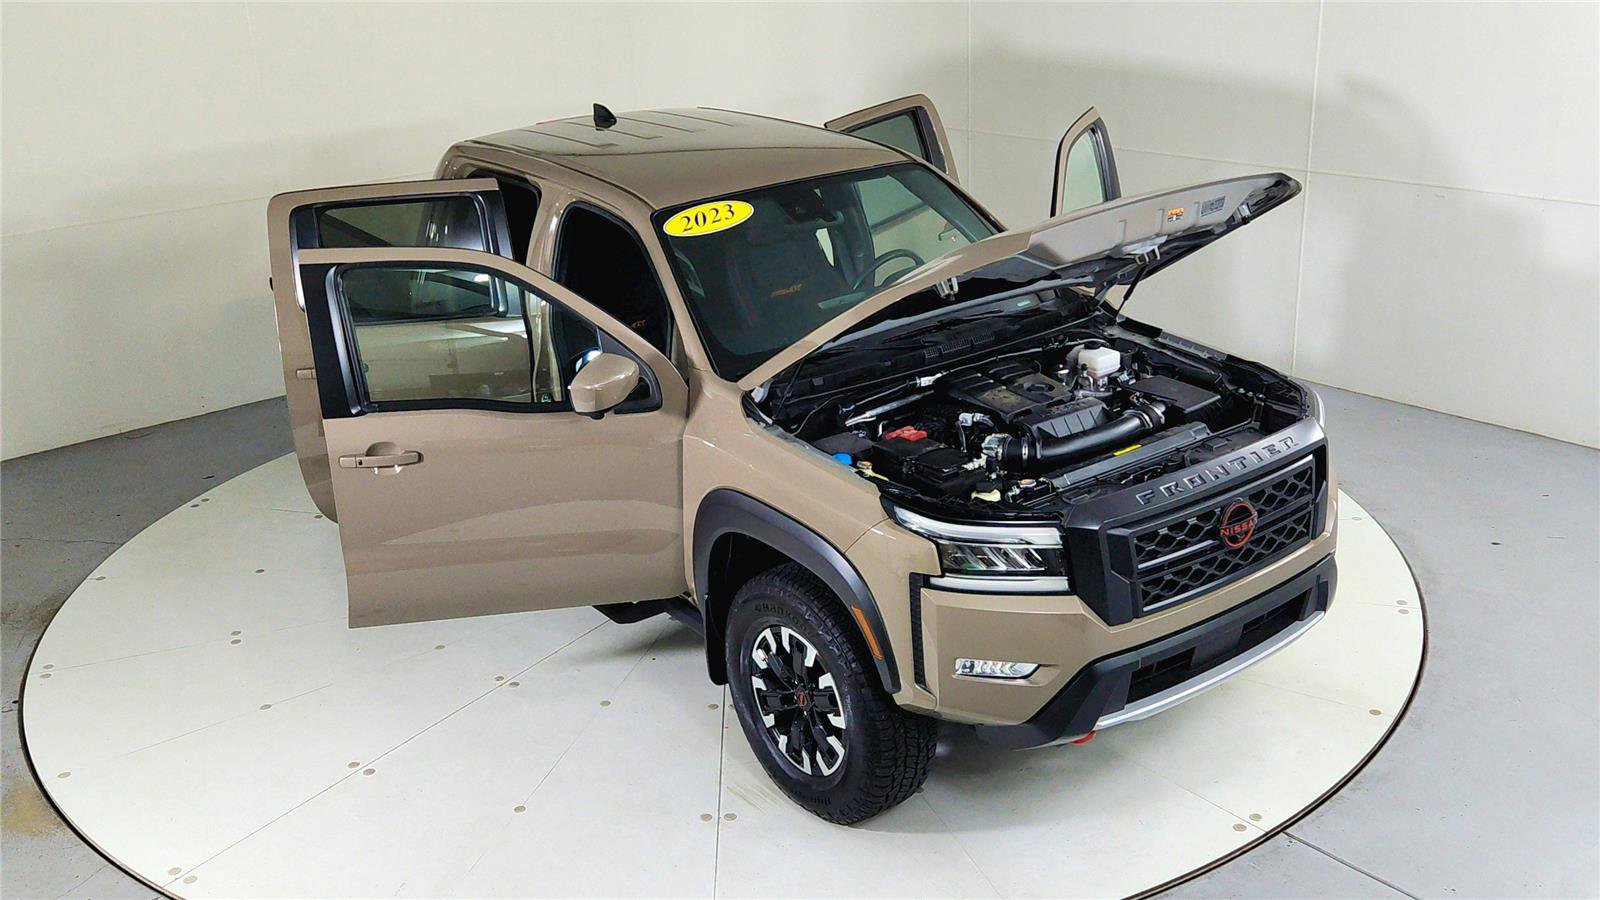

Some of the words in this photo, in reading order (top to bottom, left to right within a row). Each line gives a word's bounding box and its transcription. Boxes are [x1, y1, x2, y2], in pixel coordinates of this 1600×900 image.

[680, 203, 735, 232] 2023
[1135, 435, 1297, 505] FRONTIER
[1220, 517, 1258, 537] NISSAN
